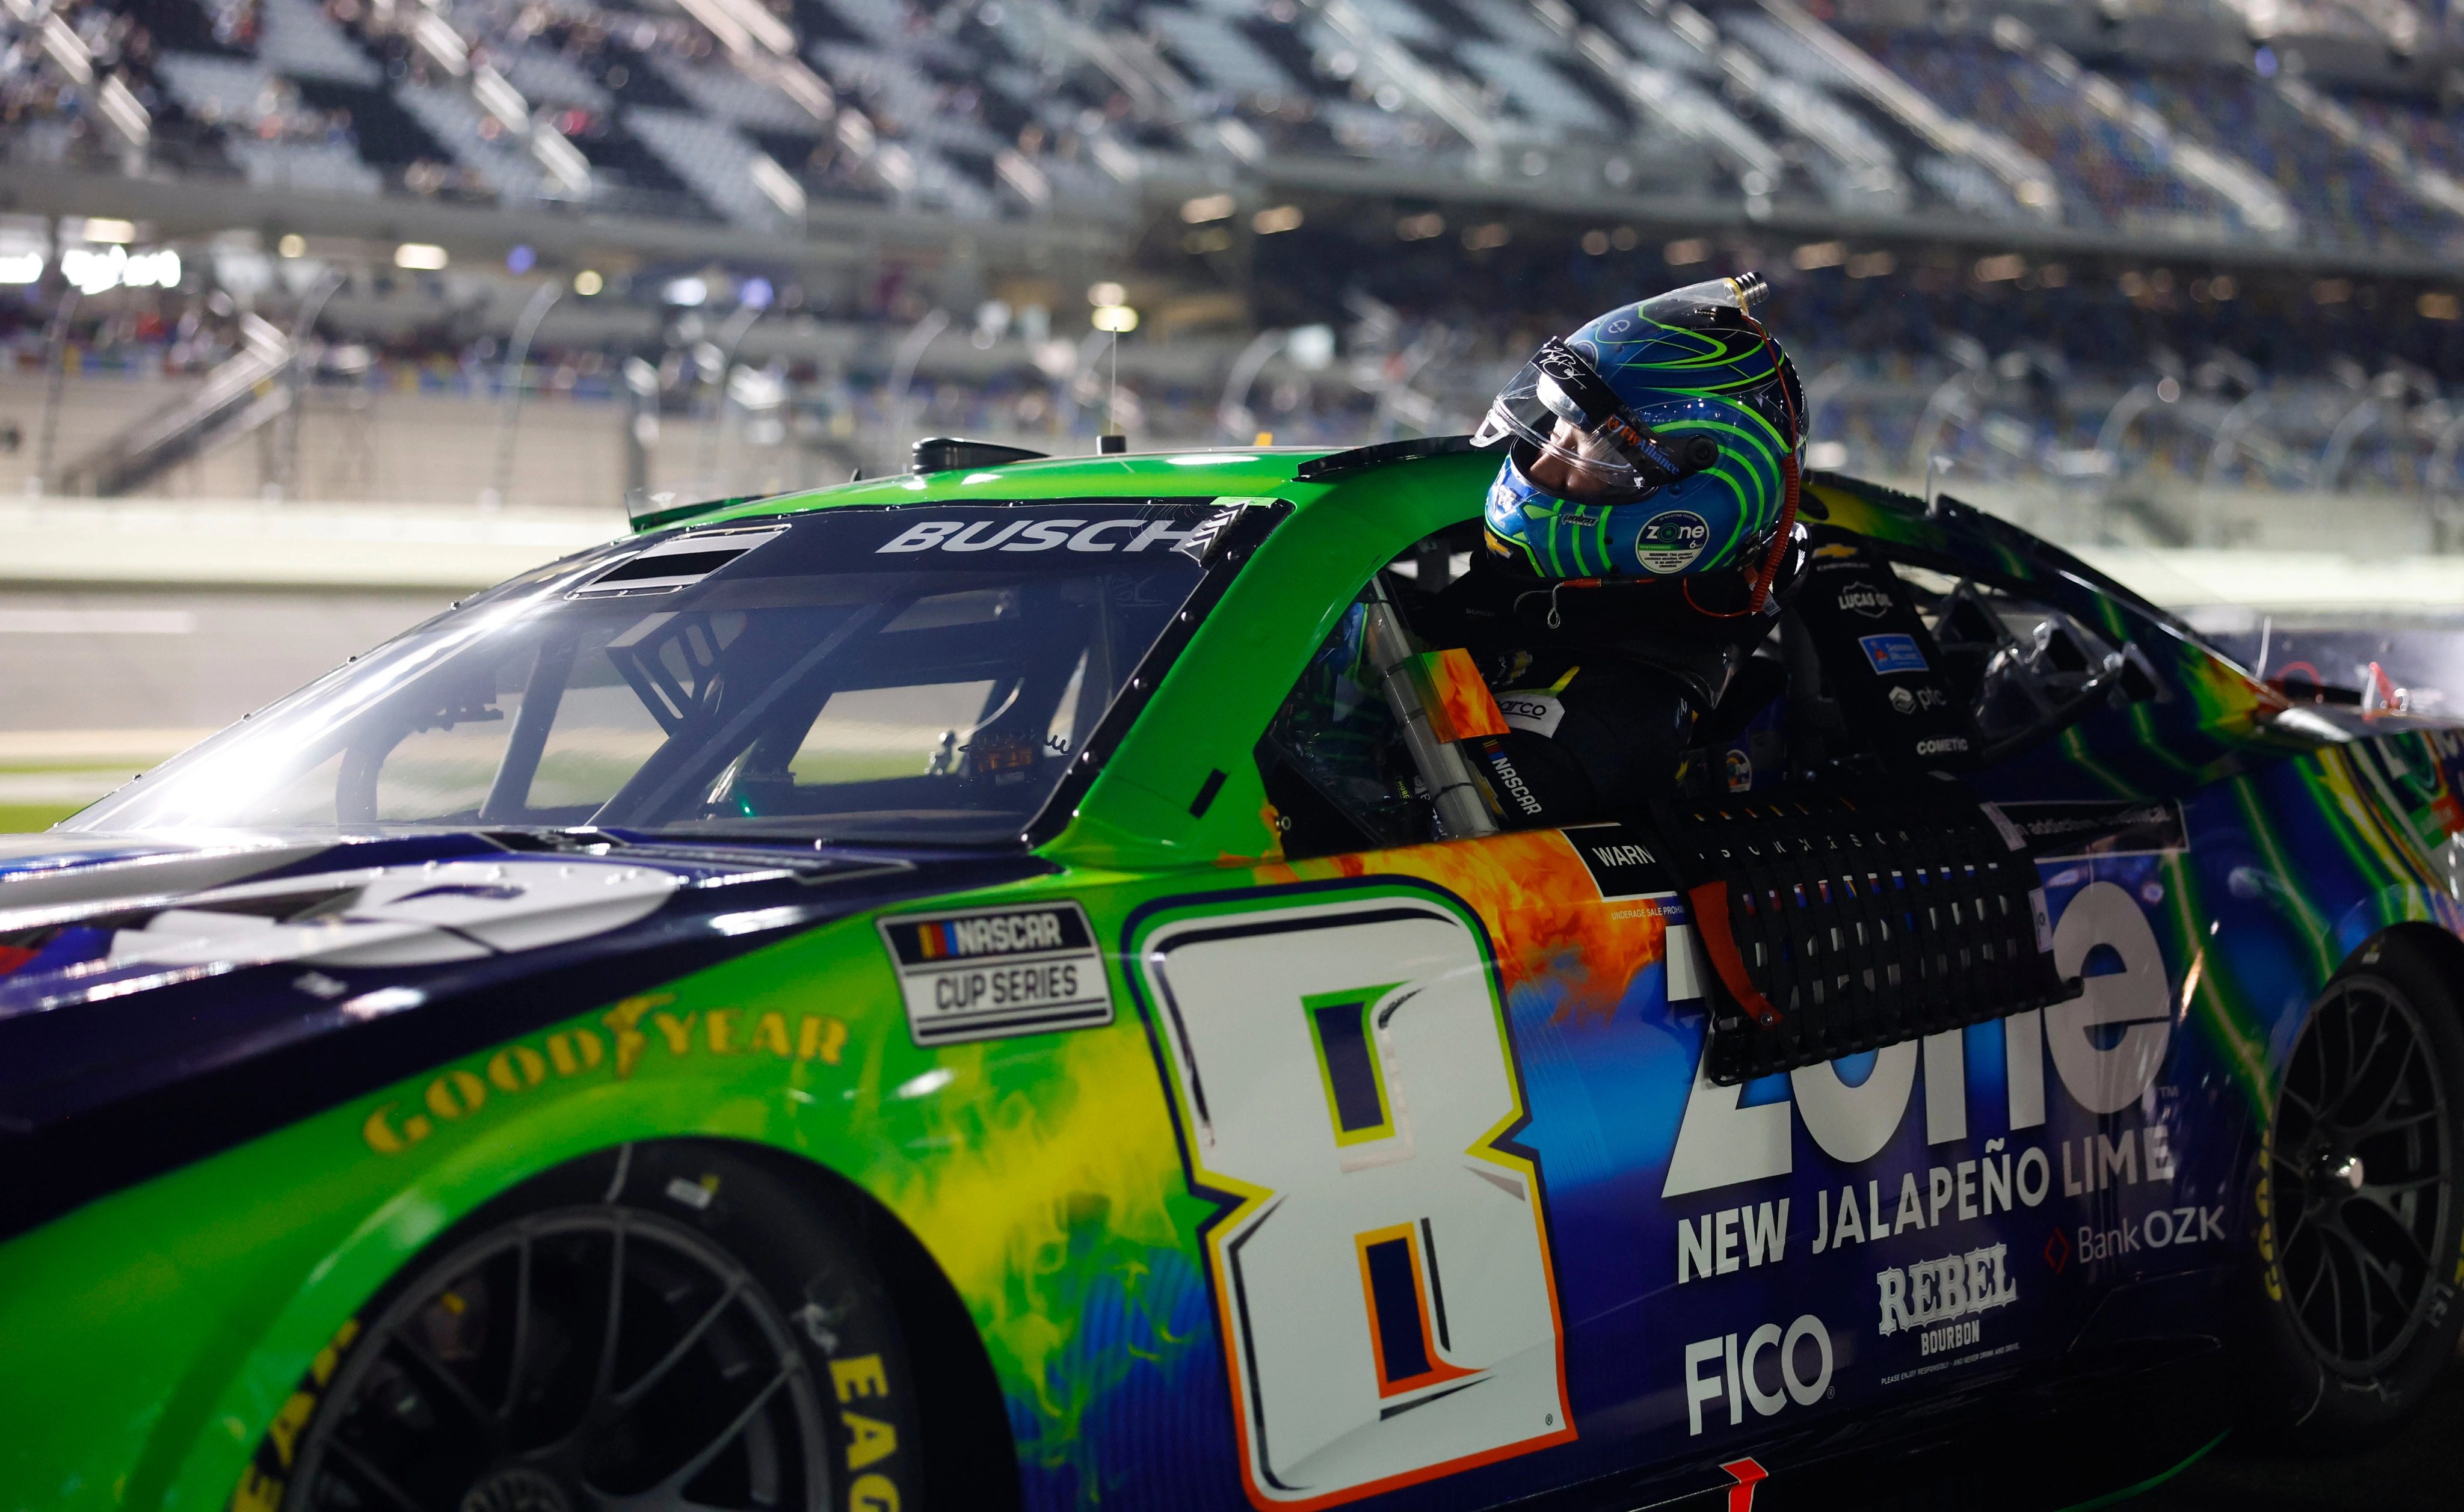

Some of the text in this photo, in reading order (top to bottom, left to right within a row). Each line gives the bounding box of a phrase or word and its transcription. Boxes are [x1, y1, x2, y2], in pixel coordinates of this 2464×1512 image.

[875, 519, 1209, 553] BUSCH
[1646, 523, 1705, 542] zone
[1838, 592, 1876, 610] LUCAS
[1496, 701, 1547, 716] arco
[1492, 757, 1542, 815] NASCAR
[1592, 844, 1656, 867] WARN
[954, 912, 1063, 955] NASCAR
[1611, 909, 1646, 920] UNDERAGE
[1646, 907, 1663, 917] SALE
[935, 965, 1078, 1011] CUP SERIES
[363, 998, 847, 1154] GOODYEAR
[1136, 884, 1575, 1507] 8
[1678, 1126, 2175, 1285] NEW JALAPEÑO LIME
[2143, 1206, 2226, 1247] OZK
[1876, 1241, 2019, 1337] REBEL
[1921, 1320, 1980, 1357] BOURBON
[1685, 1314, 1834, 1437] FICO
[1880, 1373, 1900, 1386] PLEASE
[1901, 1369, 1917, 1380] ENJOY
